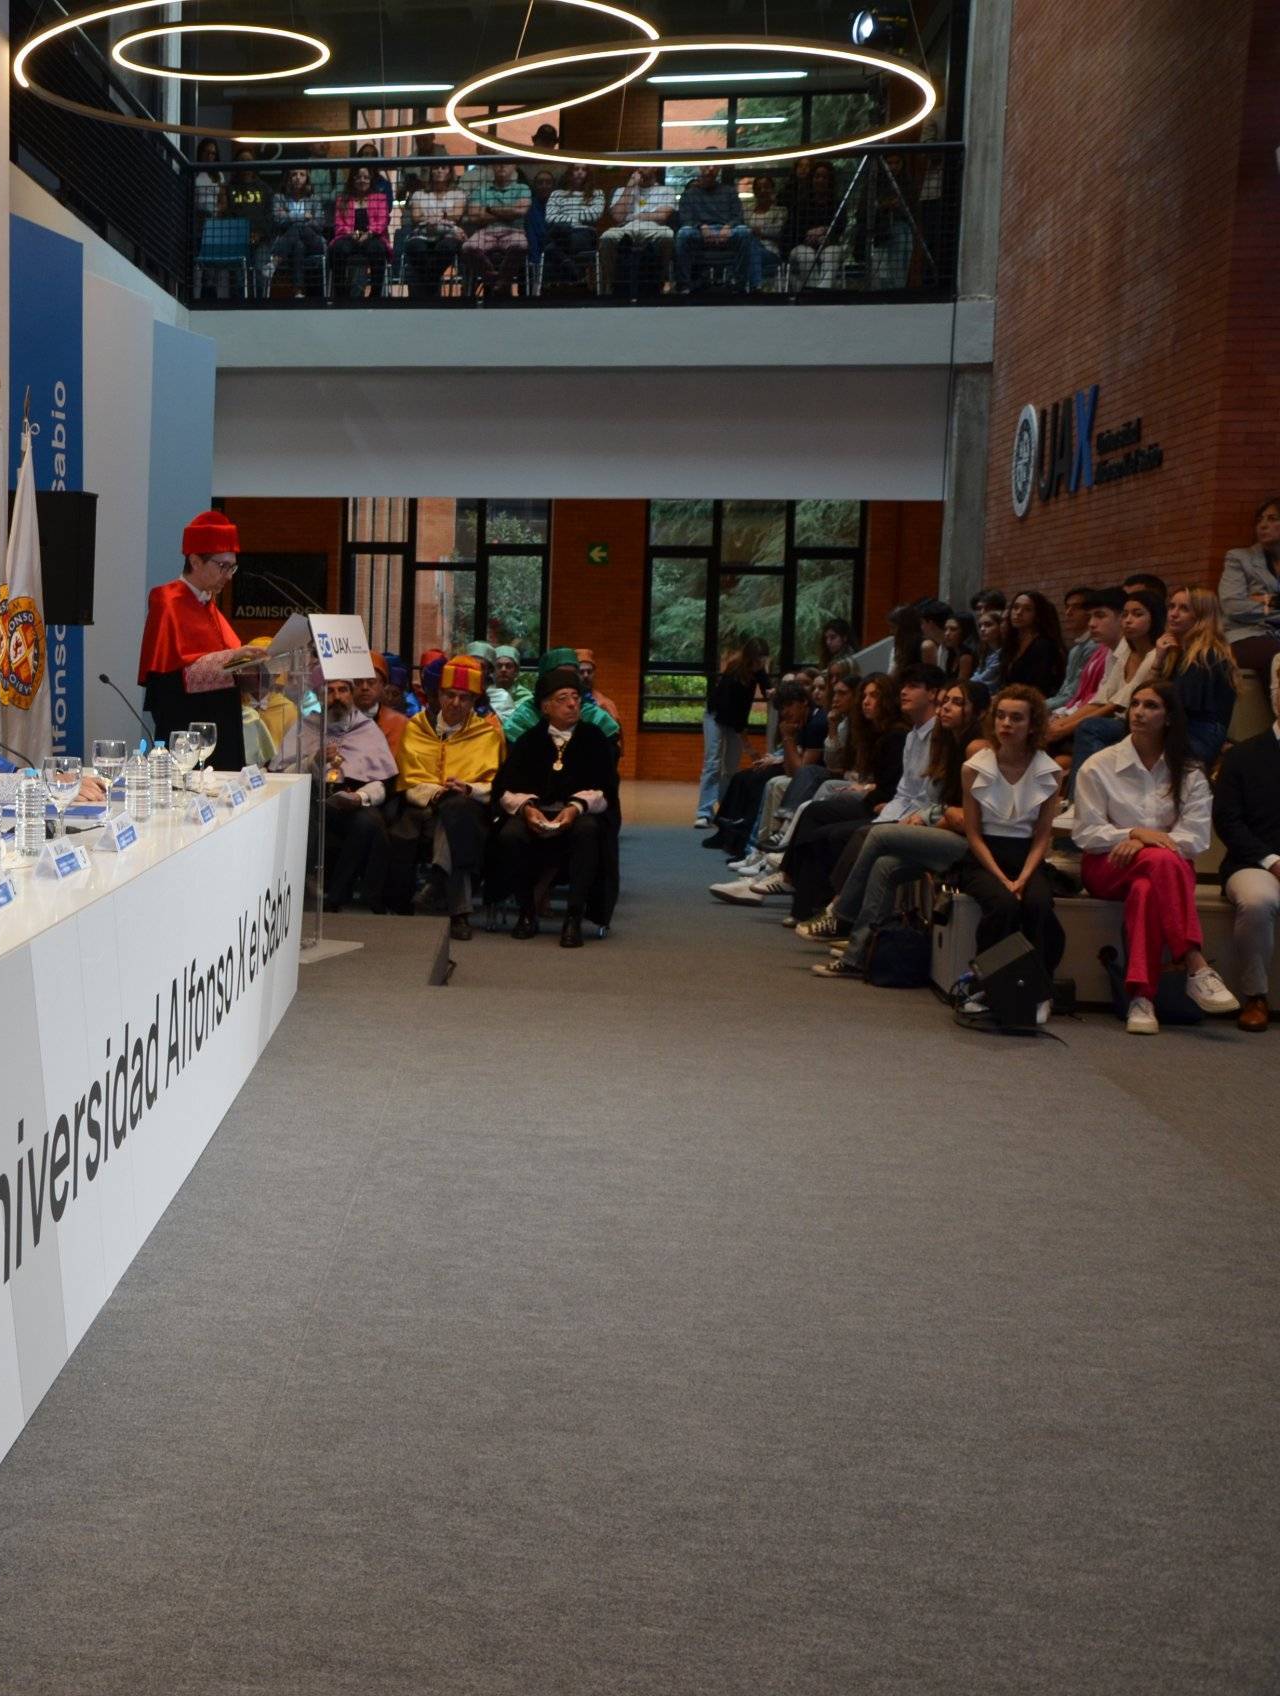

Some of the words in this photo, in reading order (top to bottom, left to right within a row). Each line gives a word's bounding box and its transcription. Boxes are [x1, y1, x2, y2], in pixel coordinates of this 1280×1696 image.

[1038, 384, 1100, 501] UAX
[331, 636, 352, 655] UAX
[166, 945, 234, 1089] Alfonso
[236, 910, 247, 1000] X
[249, 896, 261, 983] el
[262, 871, 291, 966] Sabio
